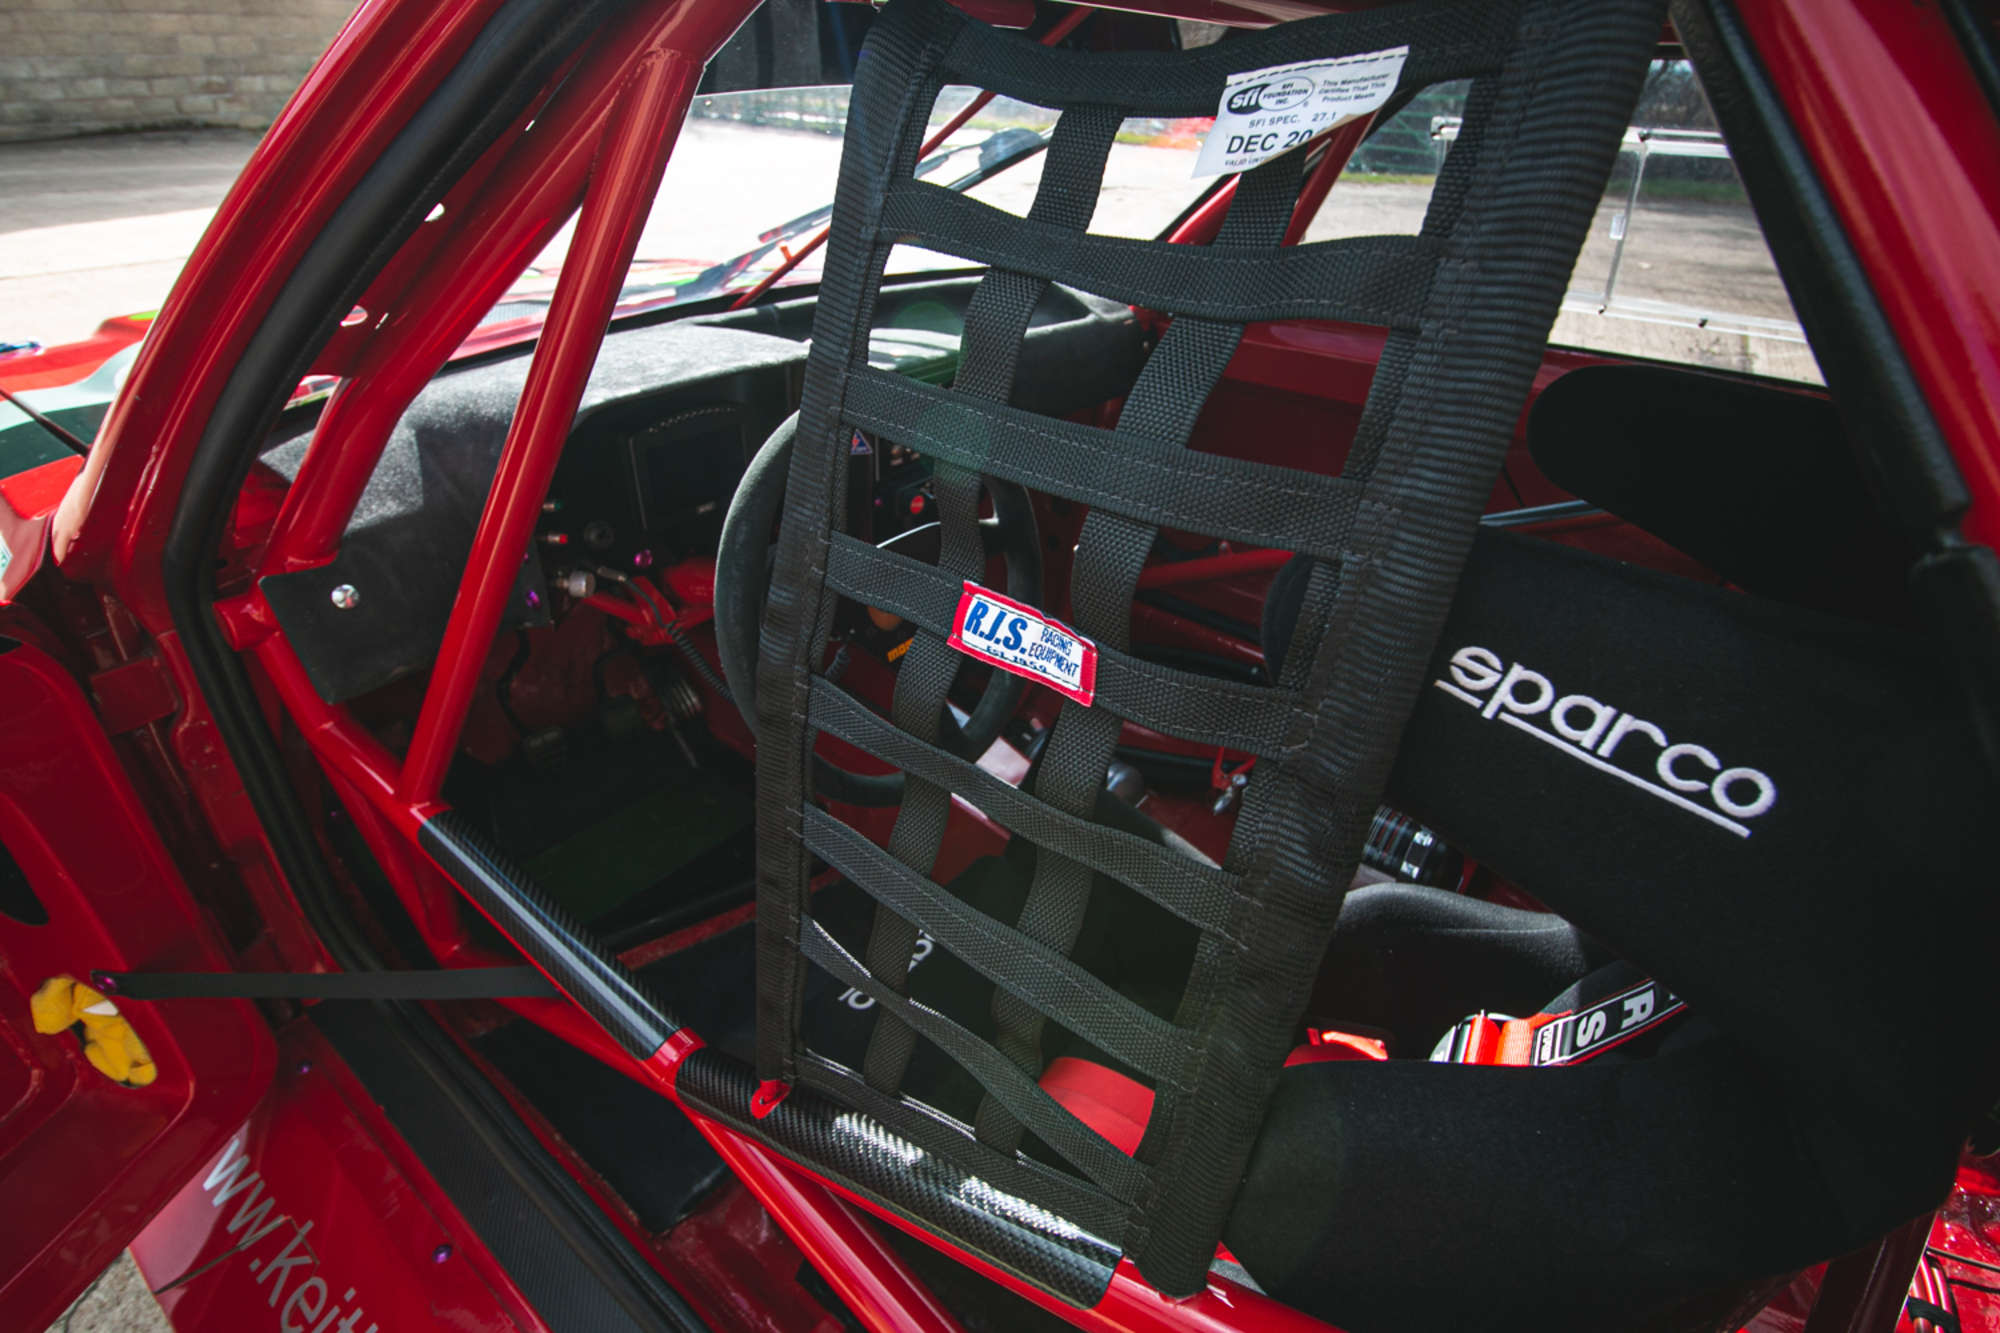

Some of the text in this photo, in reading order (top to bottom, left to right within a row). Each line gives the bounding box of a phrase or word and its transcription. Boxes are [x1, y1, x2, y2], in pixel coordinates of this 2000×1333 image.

[1229, 86, 1260, 110] sfi
[1262, 88, 1309, 100] FOUNDATION
[1248, 111, 1337, 129] SFI SPEC. 27.1
[1225, 132, 1279, 155] DEC
[964, 600, 1028, 655] R.J.S.
[1040, 627, 1073, 657] RACING
[1028, 642, 1080, 678] EQUIPMENT
[1449, 645, 1777, 819] sparco
